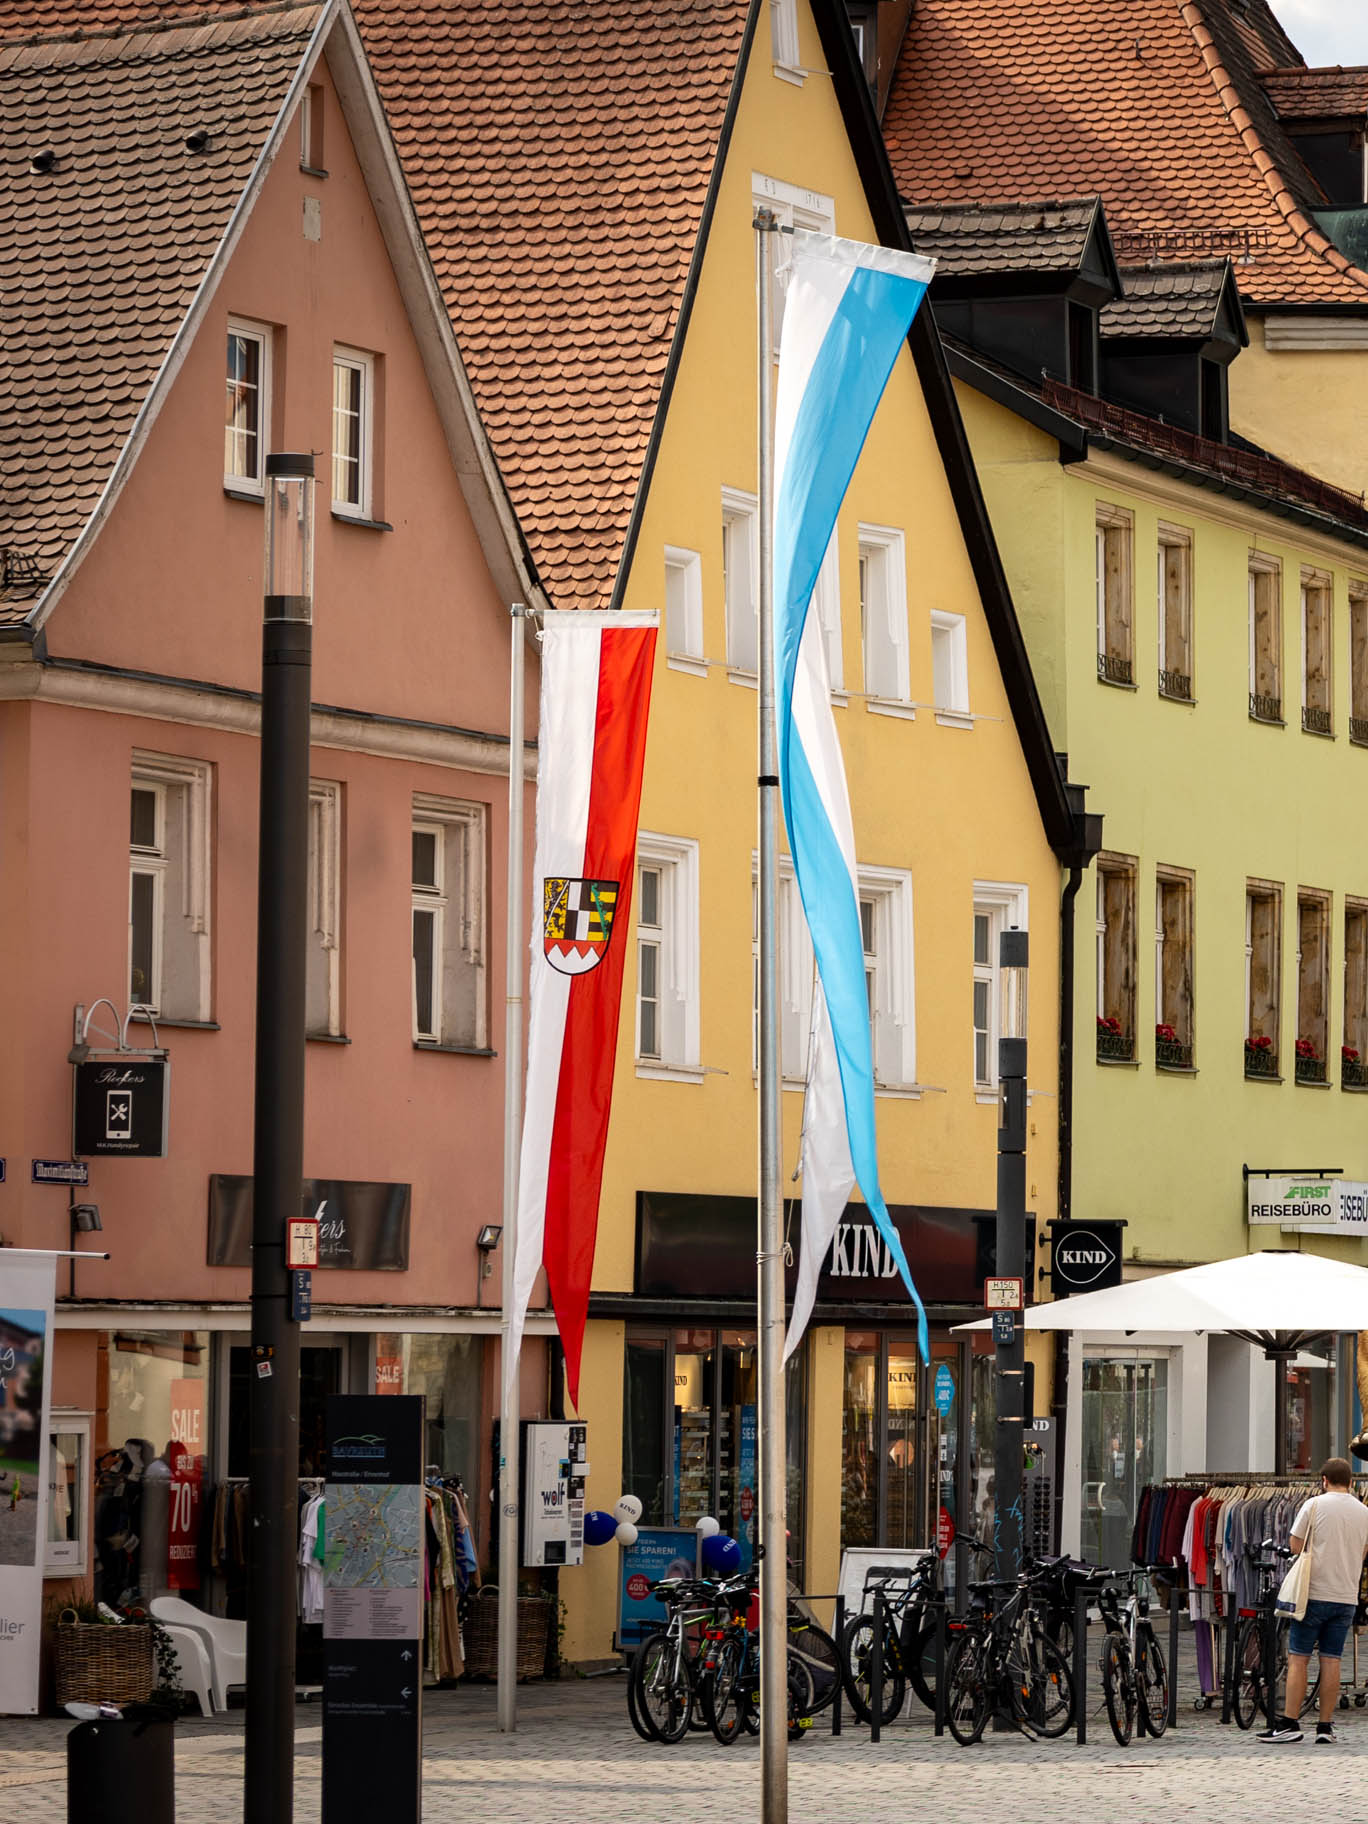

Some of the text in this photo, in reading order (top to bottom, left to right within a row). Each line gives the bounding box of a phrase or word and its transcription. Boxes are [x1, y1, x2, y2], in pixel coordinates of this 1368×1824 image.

[1284, 1186, 1331, 1199] FIRST
[1251, 1201, 1331, 1217] REISEBÜRO
[1062, 1250, 1107, 1264] KIND
[376, 1365, 400, 1384] SALE
[171, 1409, 200, 1443] SALE
[541, 1482, 565, 1506] wolf
[620, 1502, 636, 1516] KIND
[641, 1547, 677, 1555] SPAREN!
